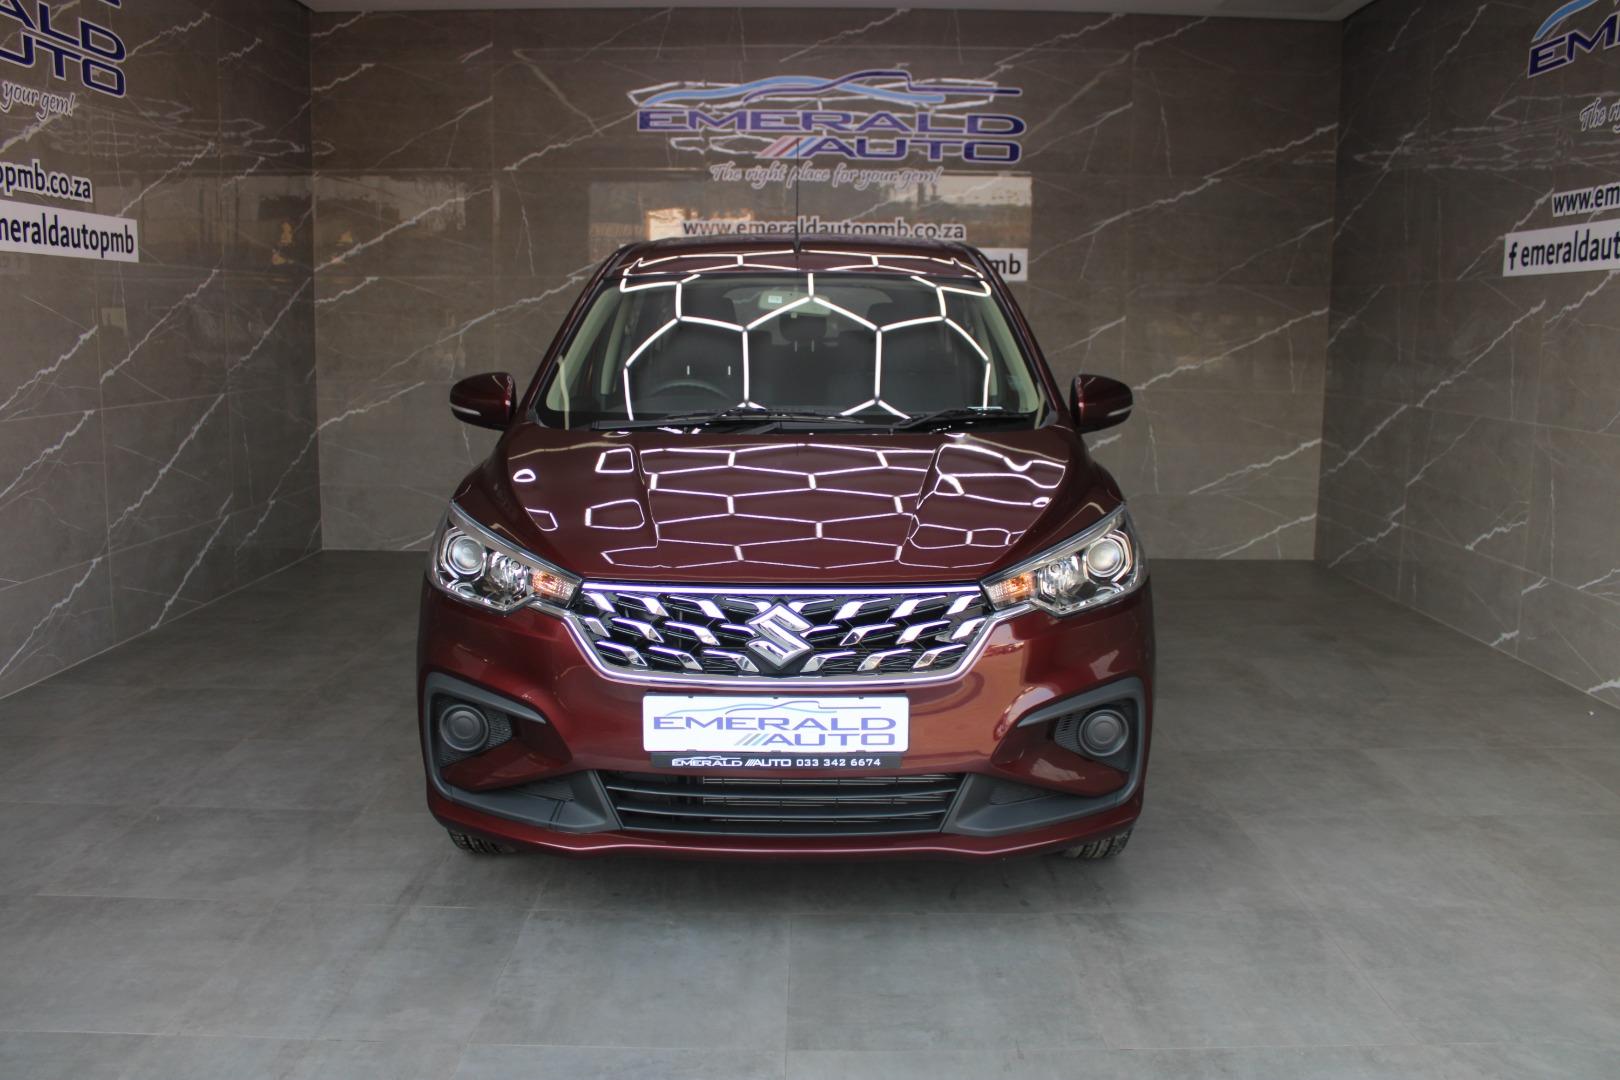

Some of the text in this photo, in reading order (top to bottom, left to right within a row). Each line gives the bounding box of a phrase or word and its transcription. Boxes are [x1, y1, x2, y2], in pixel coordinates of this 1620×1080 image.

[1527, 10, 1620, 78] EM
[0, 81, 76, 121] your gem!
[1580, 97, 1607, 131] The
[637, 108, 1027, 136] EMERALD
[801, 136, 1022, 163] AUTO
[709, 160, 944, 191] The right place for your gem!
[653, 716, 897, 731] EMERALD
[761, 733, 895, 747] AUTO
[671, 757, 743, 767] EMERALD
[796, 758, 819, 767] 033
[823, 758, 847, 767] 342
[850, 758, 882, 767] 6674
